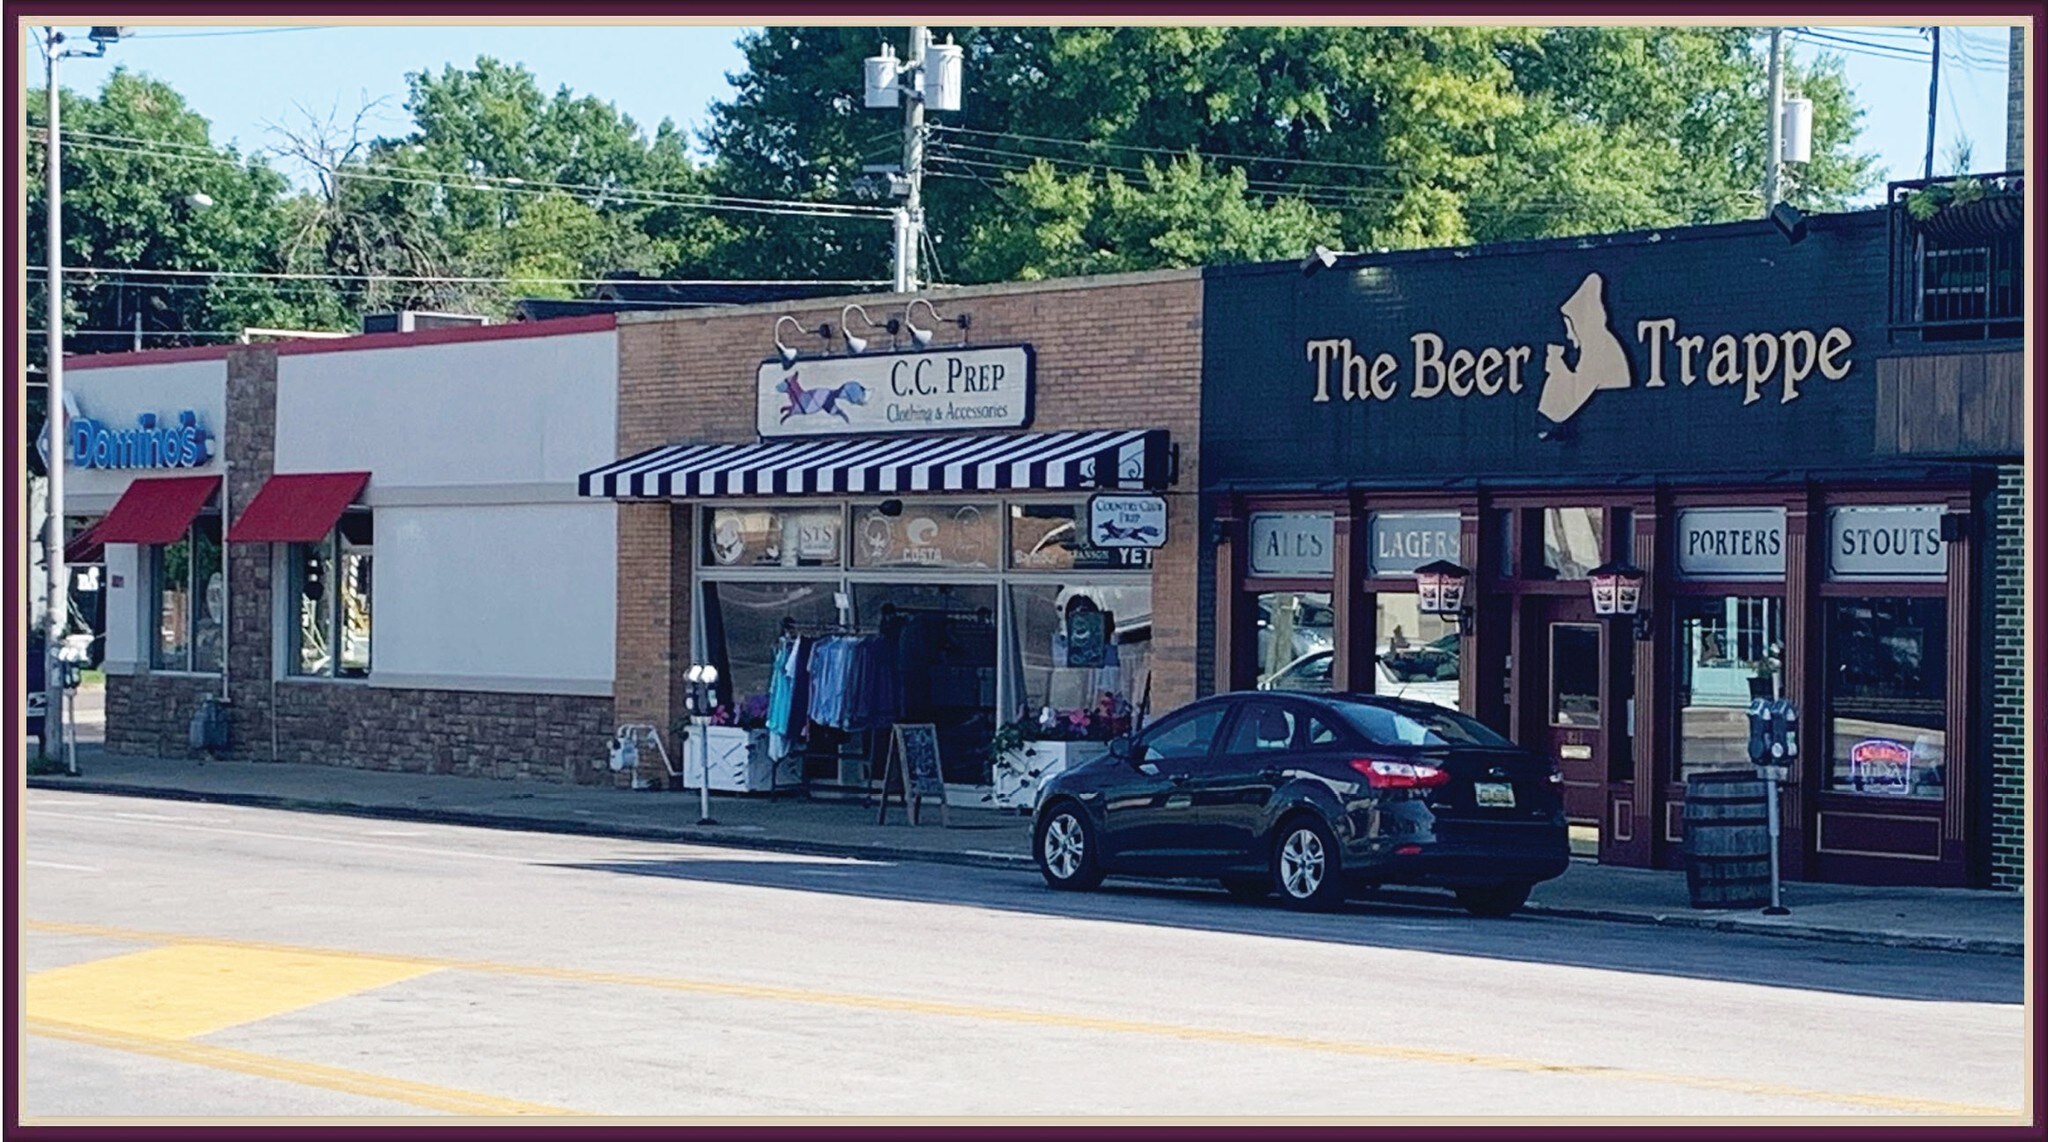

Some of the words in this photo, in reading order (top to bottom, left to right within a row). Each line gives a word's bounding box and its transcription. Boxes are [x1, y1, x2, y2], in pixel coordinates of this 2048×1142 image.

[1306, 337, 1397, 402] The
[1410, 332, 1531, 398] Beer
[1638, 317, 1853, 406] Trappe
[890, 358, 938, 397] C.C.
[934, 407, 943, 420] &
[945, 402, 1009, 421] Accessories
[72, 409, 206, 470] Domino's
[902, 547, 943, 562] COSTA
[1266, 530, 1323, 557] ALES
[1378, 530, 1461, 559] LAGERS
[1688, 529, 1781, 556] PORTERS
[1841, 528, 1941, 556] STOUTS
